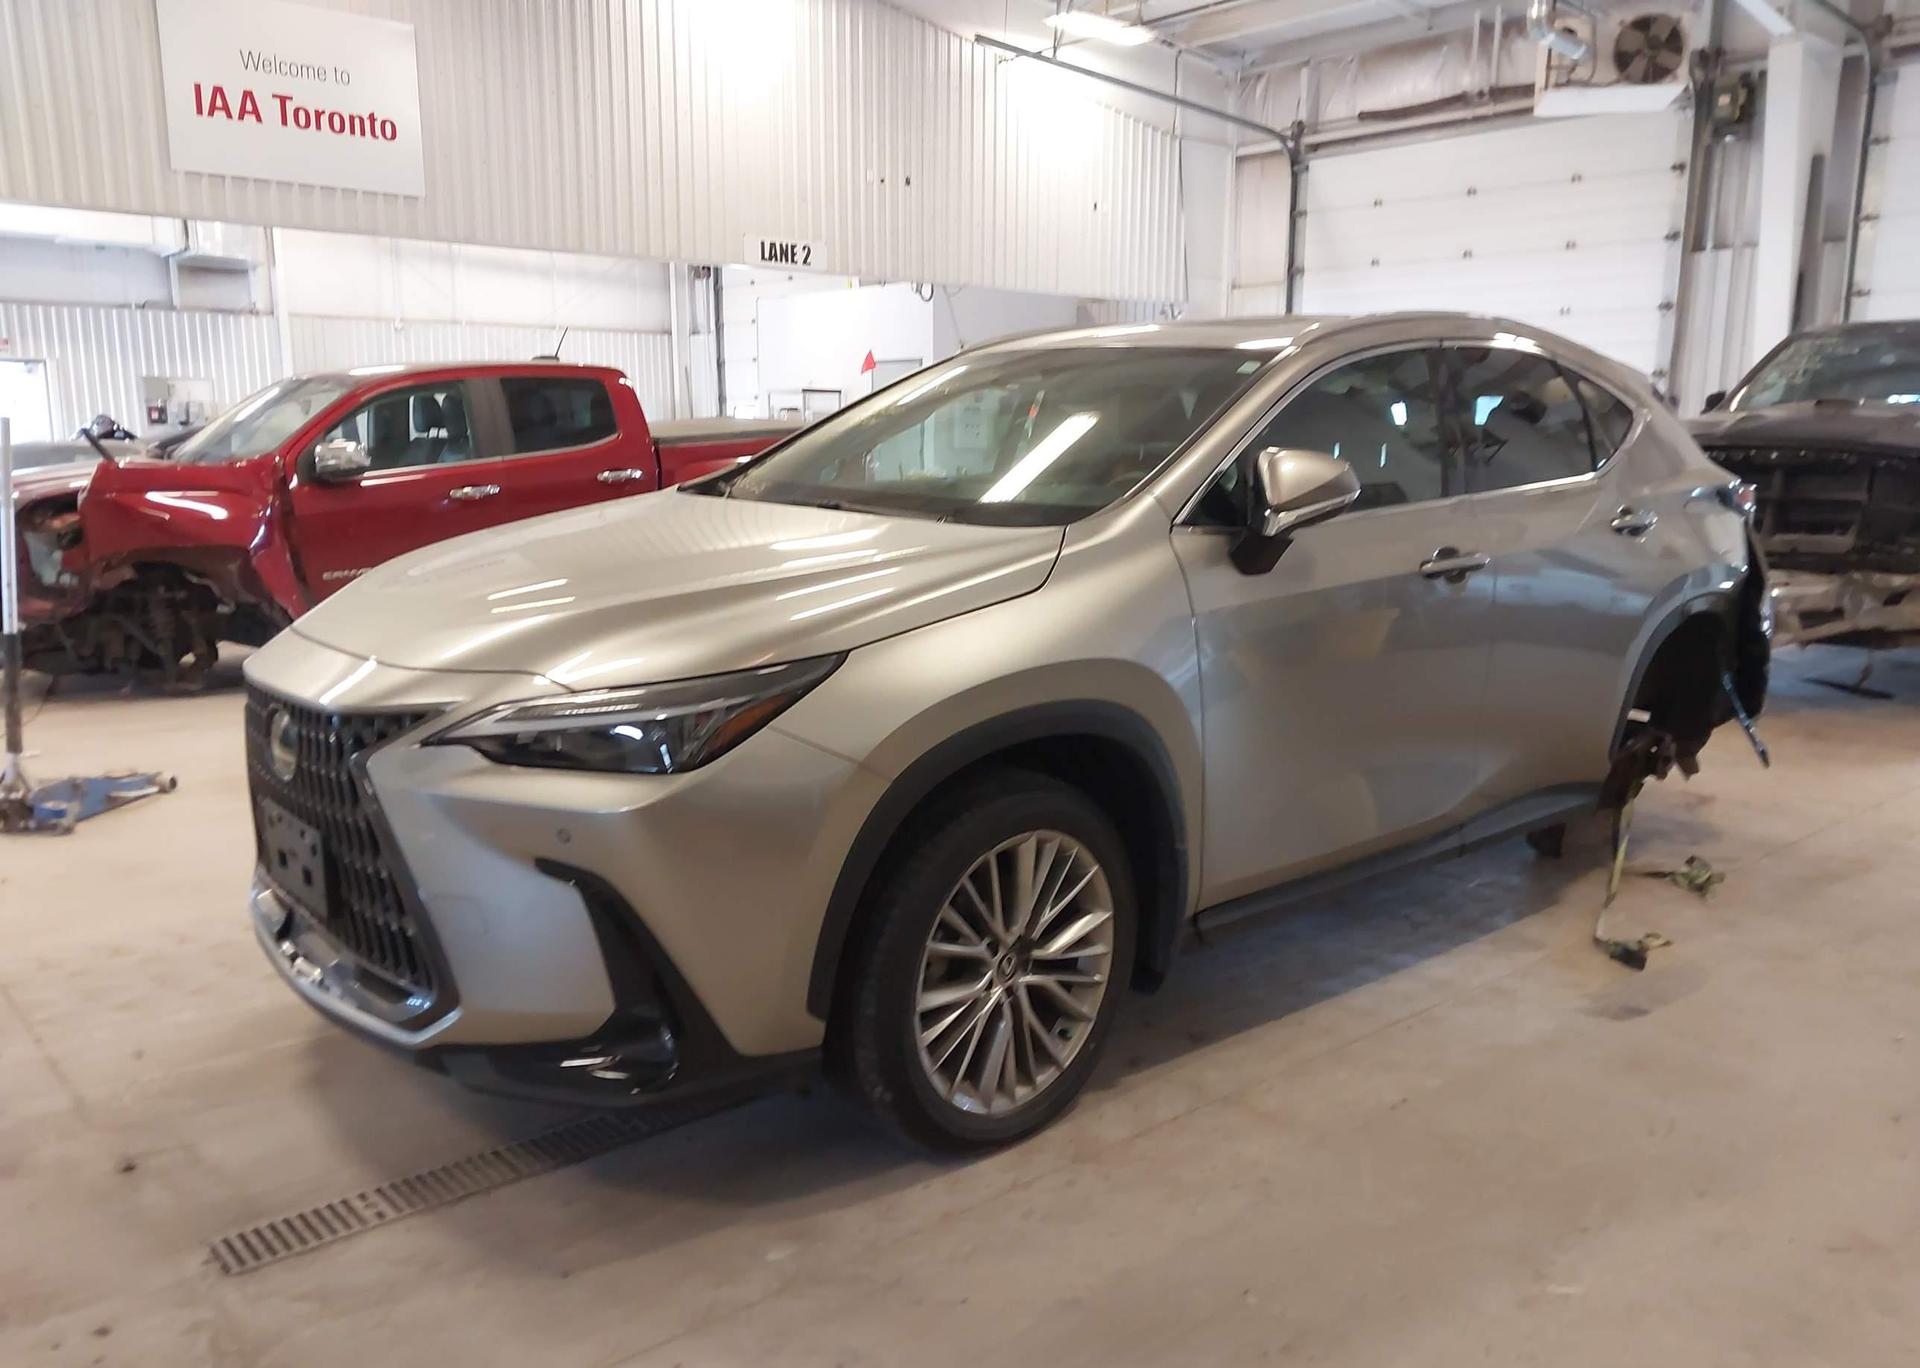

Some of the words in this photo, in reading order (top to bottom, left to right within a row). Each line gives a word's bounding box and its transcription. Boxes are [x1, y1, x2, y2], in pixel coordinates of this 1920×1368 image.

[239, 48, 327, 82] Welcome
[333, 65, 351, 86] to
[193, 82, 263, 124] IAA
[272, 92, 398, 142] Toronto
[760, 240, 798, 264] LANE
[802, 244, 812, 266] 2
